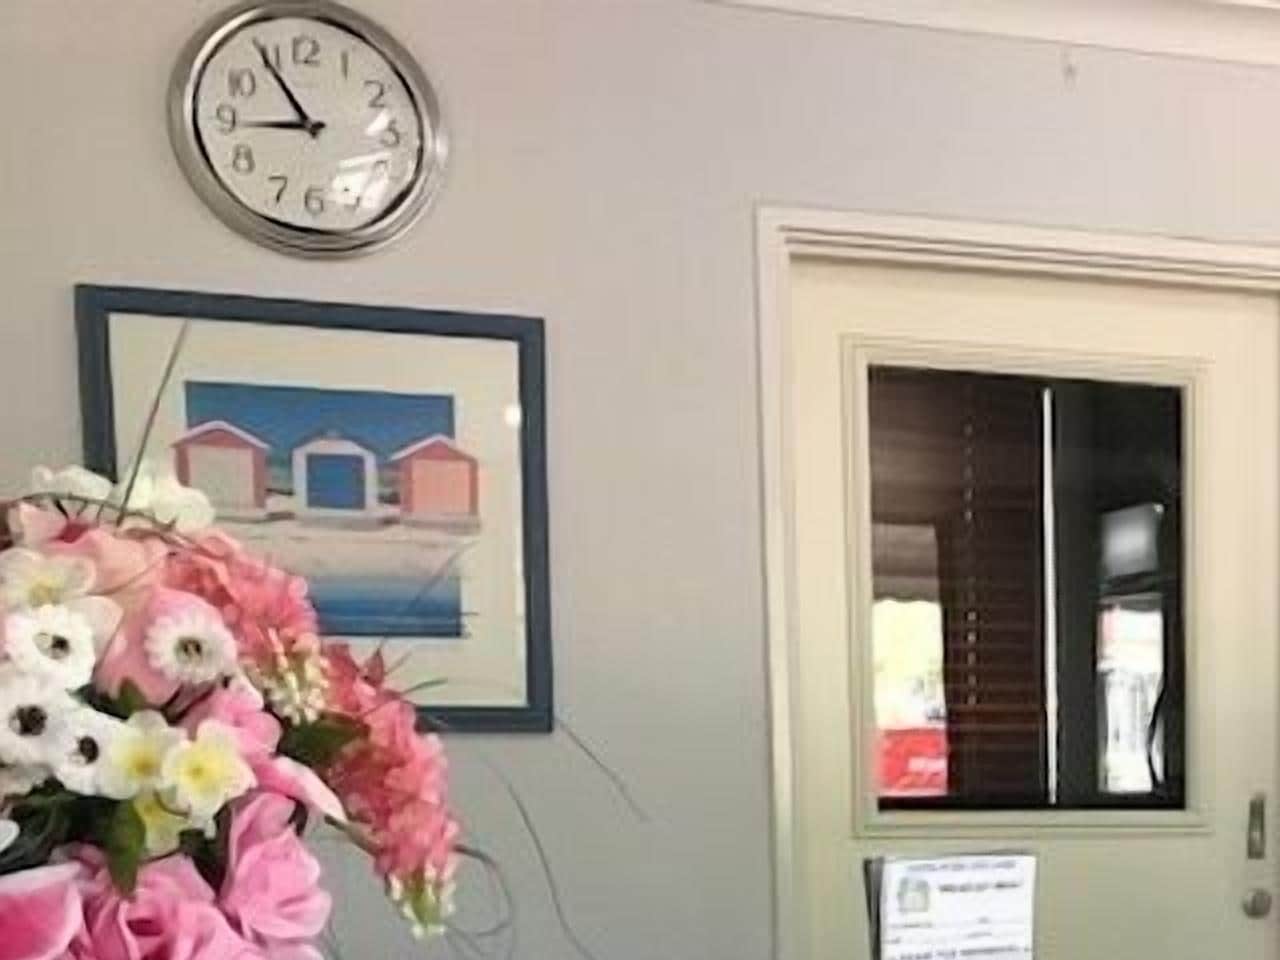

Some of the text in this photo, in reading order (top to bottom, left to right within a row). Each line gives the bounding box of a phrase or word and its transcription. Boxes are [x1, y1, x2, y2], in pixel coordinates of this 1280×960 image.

[292, 36, 320, 66] 12
[341, 51, 349, 79] 1
[227, 68, 256, 97] 10
[365, 80, 385, 108] 2
[215, 103, 236, 133] 9
[232, 144, 254, 173] 8
[268, 175, 288, 203] 7
[304, 187, 324, 215] 6
